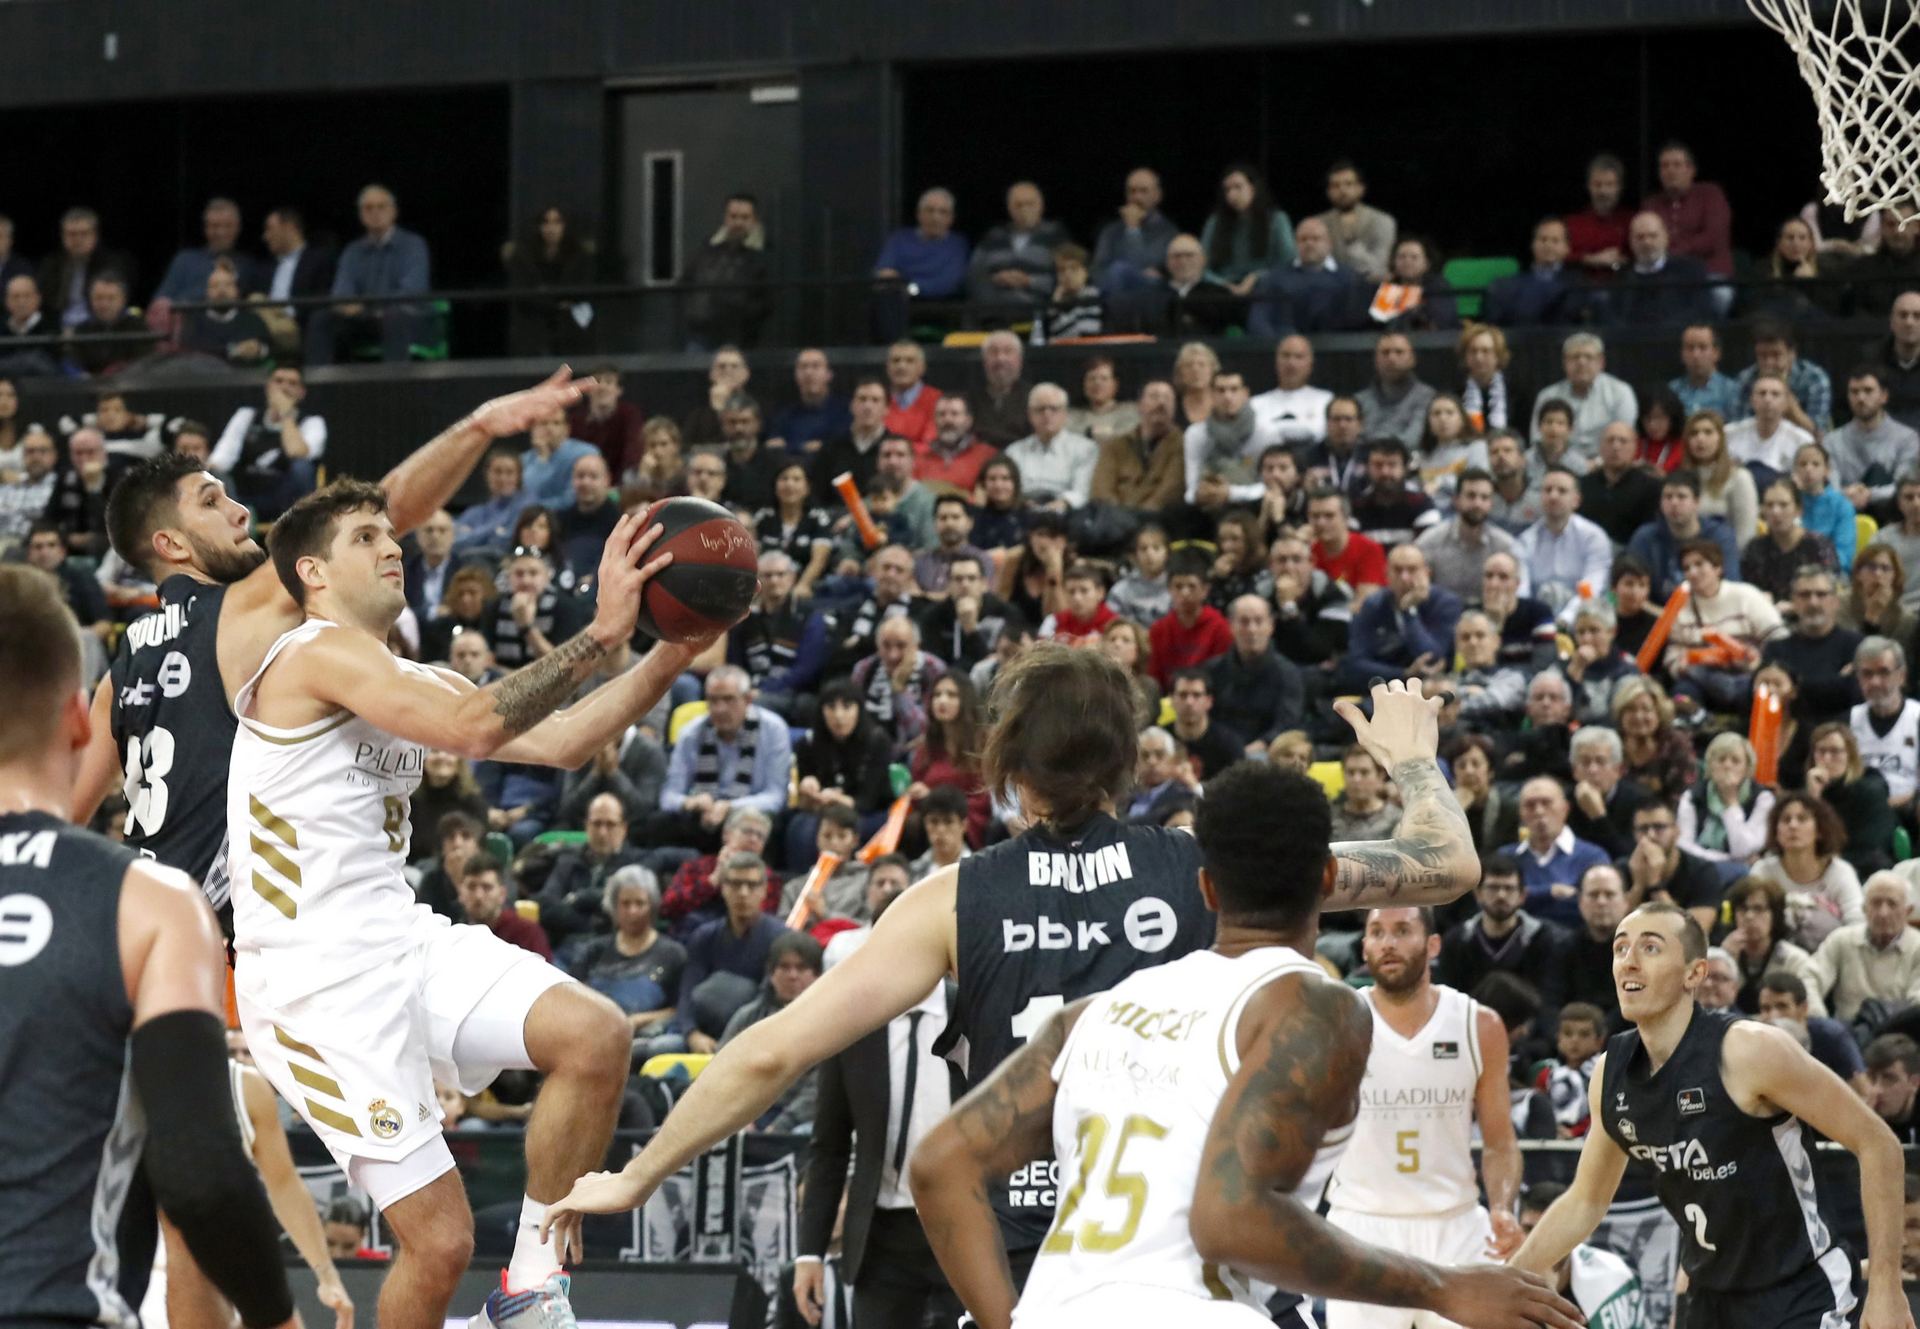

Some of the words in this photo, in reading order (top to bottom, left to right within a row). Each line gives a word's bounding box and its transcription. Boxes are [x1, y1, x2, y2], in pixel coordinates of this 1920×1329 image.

[1028, 841, 1133, 894] BALVIN
[1002, 915, 1112, 952] bbk
[1396, 1130, 1420, 1173] 5
[1041, 1113, 1171, 1255] 25
